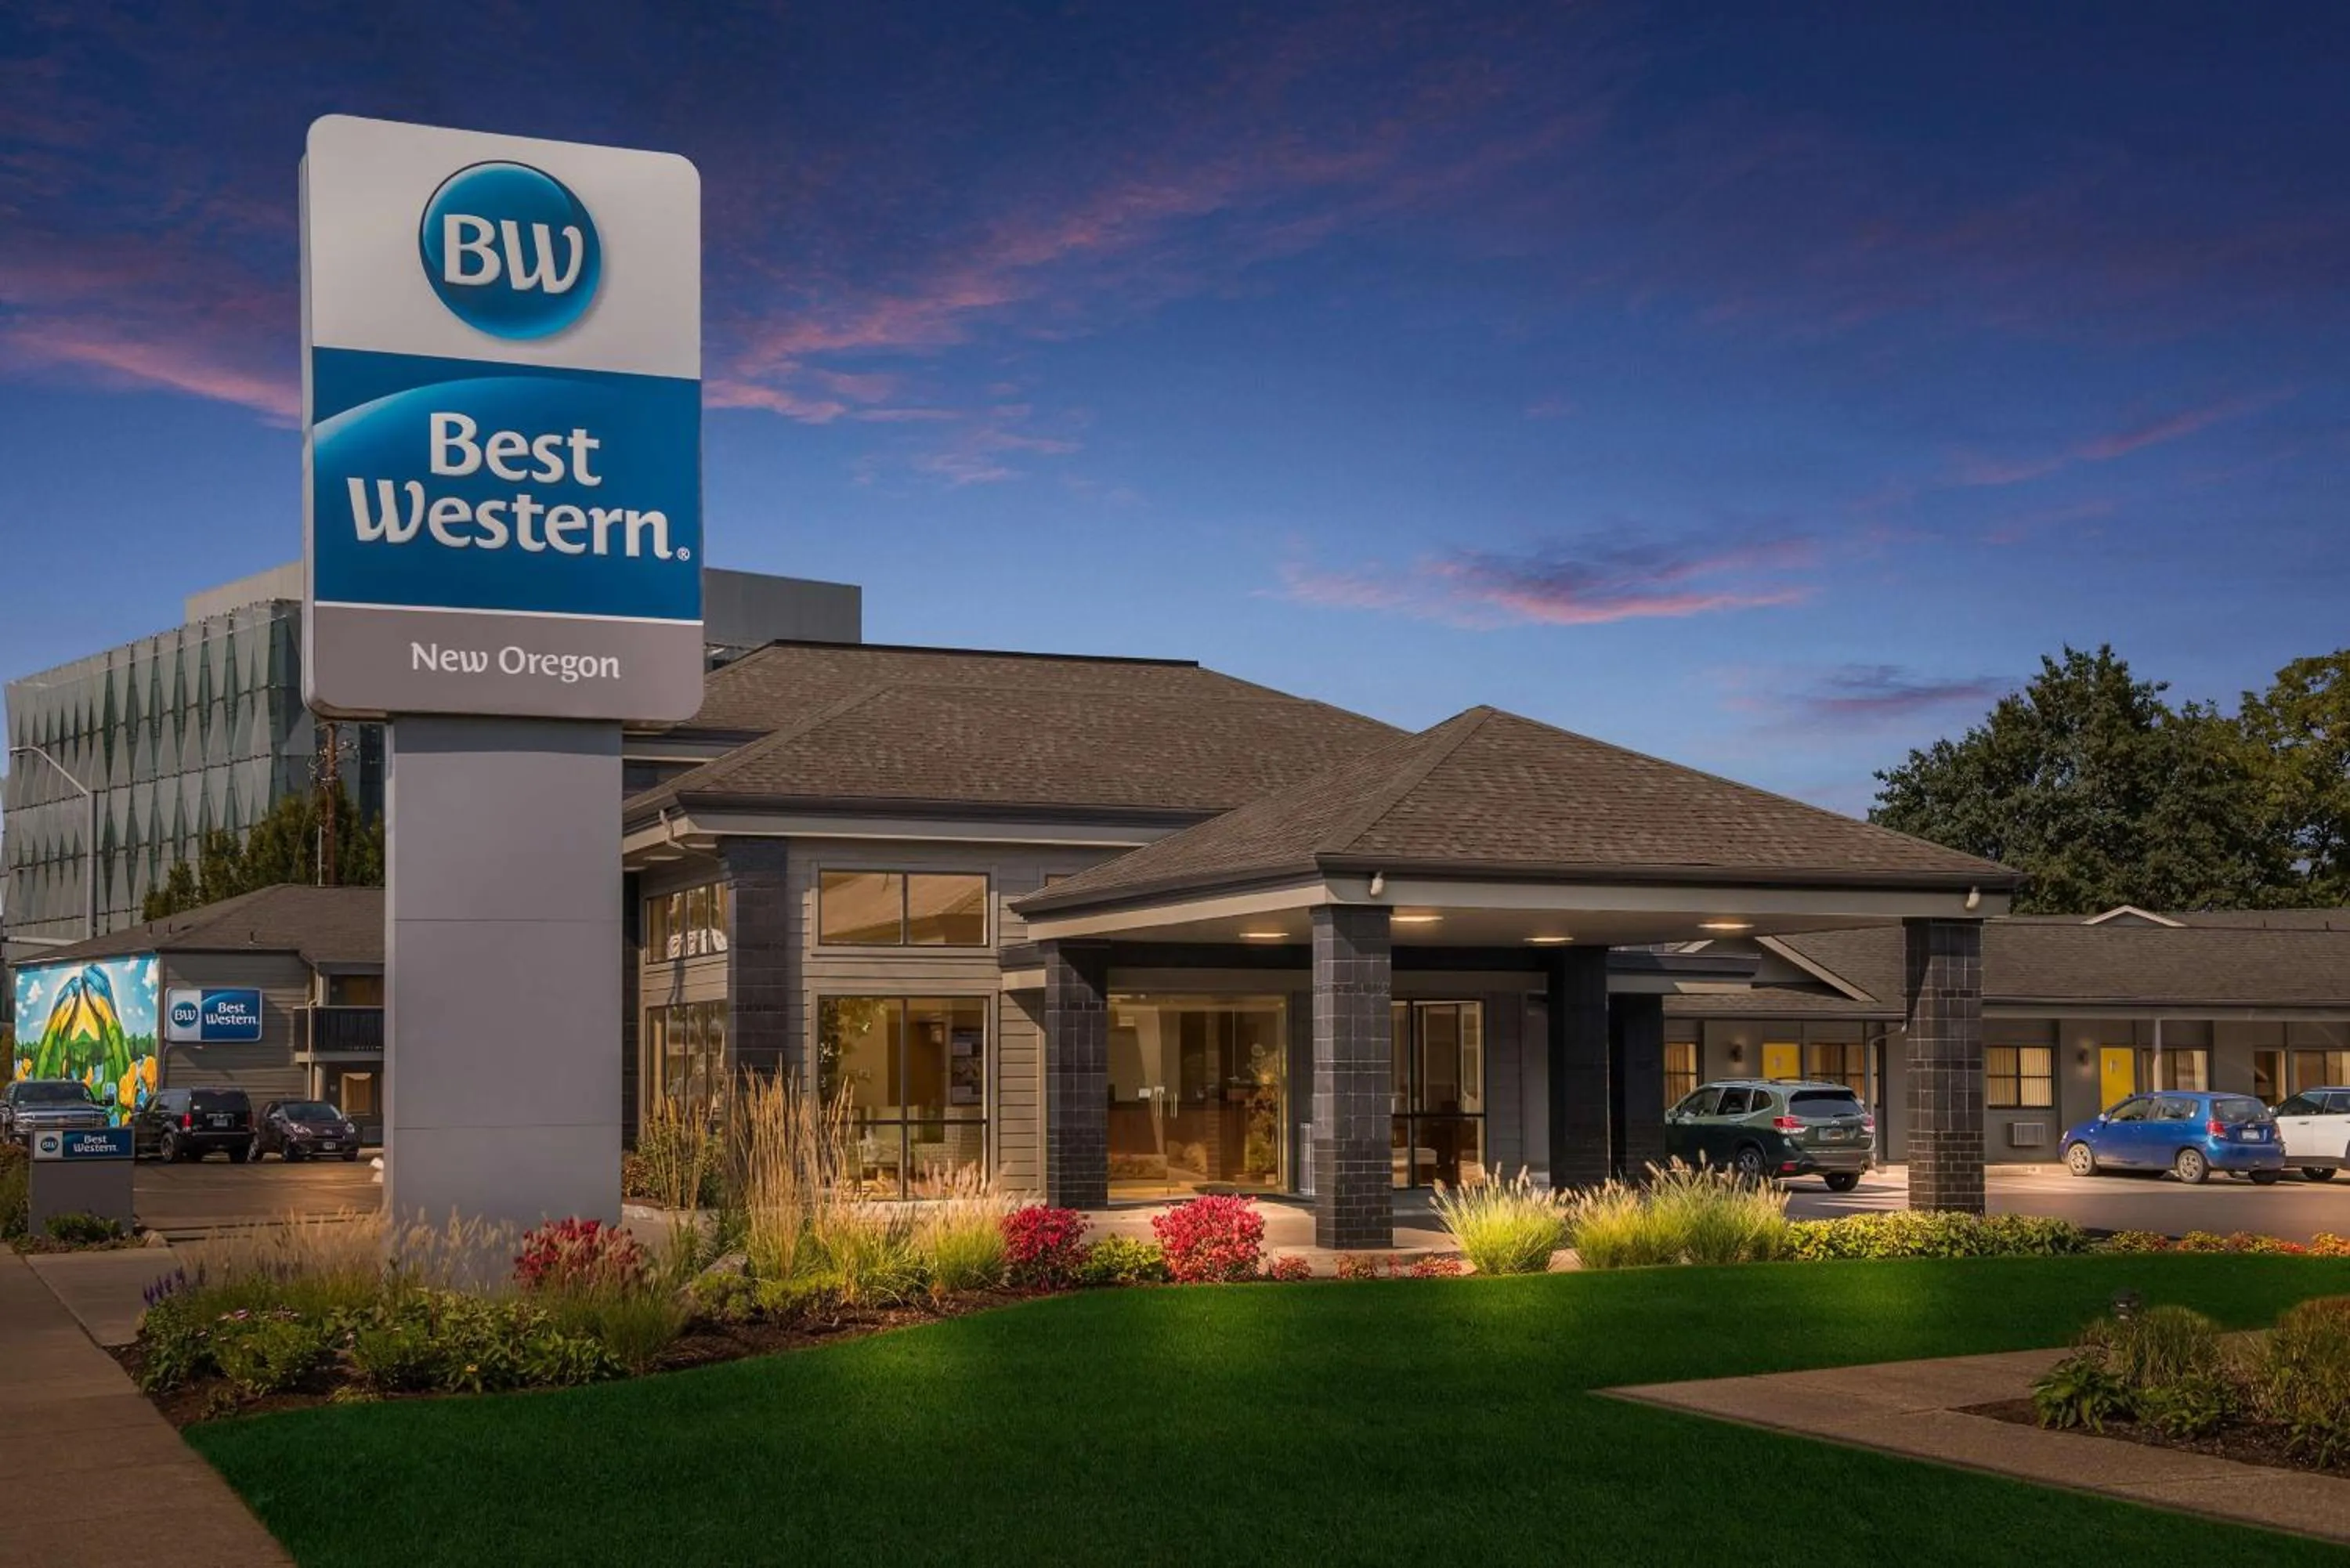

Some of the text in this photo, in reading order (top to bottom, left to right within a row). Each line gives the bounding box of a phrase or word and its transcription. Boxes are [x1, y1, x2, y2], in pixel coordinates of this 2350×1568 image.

[443, 213, 584, 294] BW
[430, 412, 602, 486] Best
[410, 641, 620, 683] New Oregon
[174, 1008, 197, 1021] BW
[217, 1002, 246, 1013] Best
[83, 1134, 107, 1143] Best
